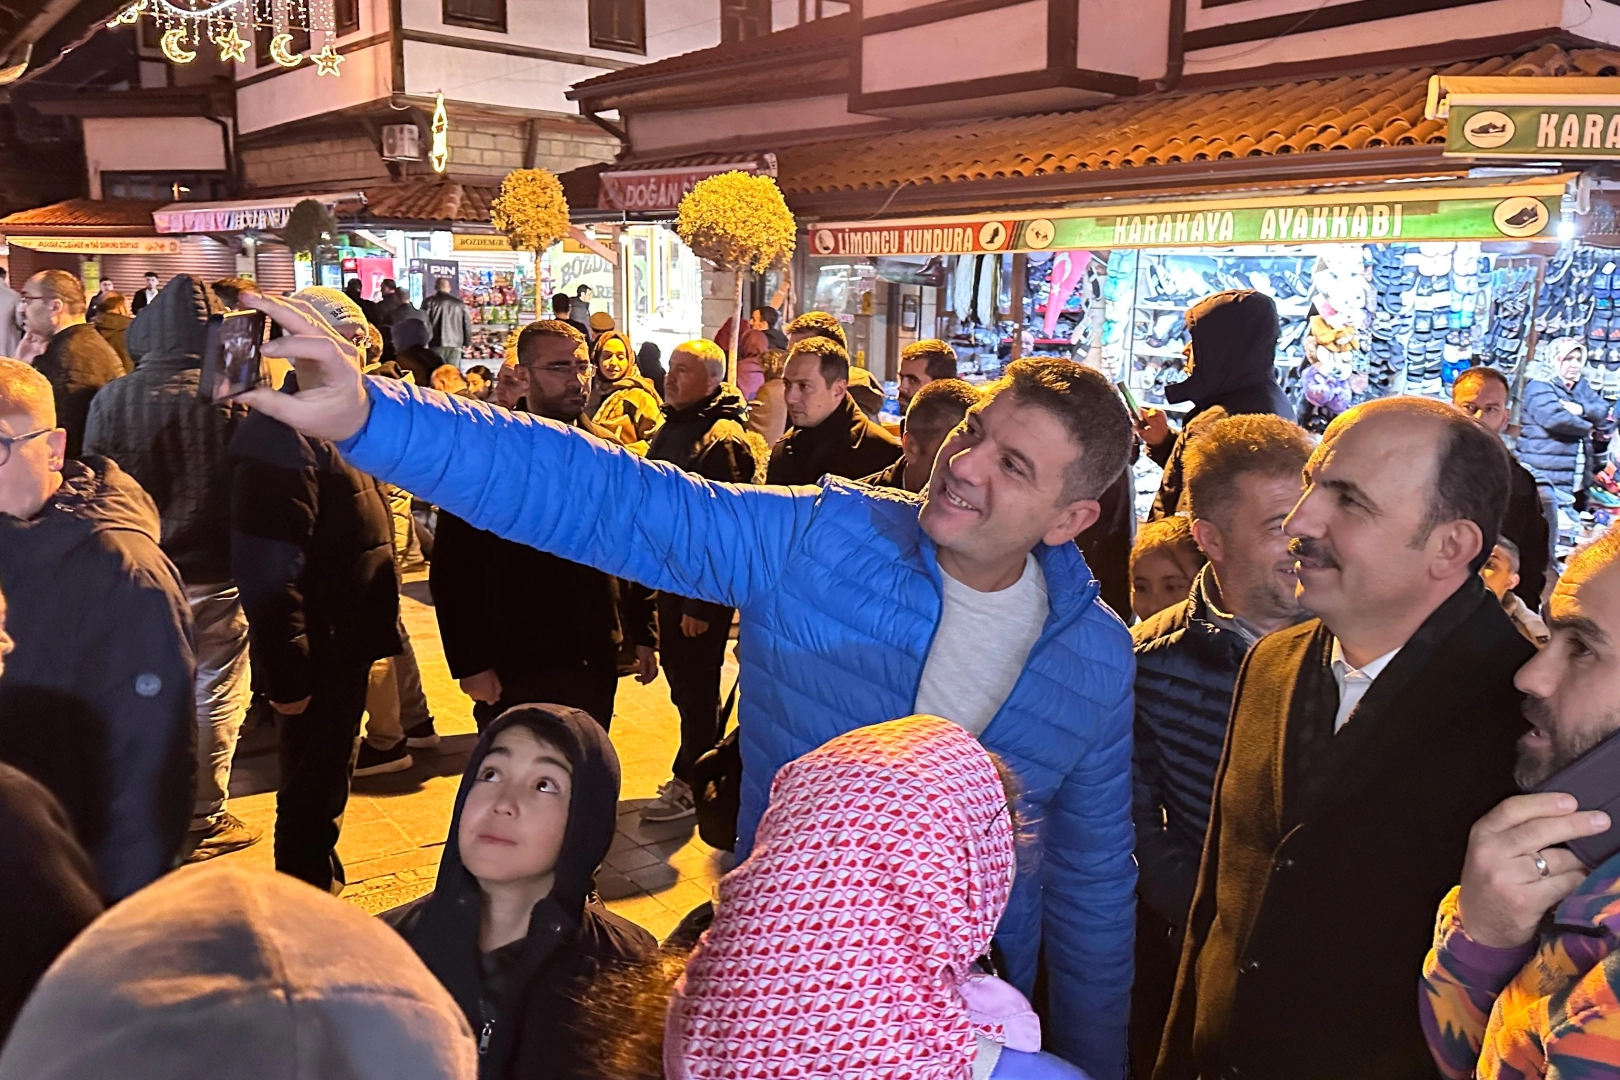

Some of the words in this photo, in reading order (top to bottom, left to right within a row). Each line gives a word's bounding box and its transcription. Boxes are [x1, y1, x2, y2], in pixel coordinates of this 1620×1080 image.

[1536, 113, 1620, 149] KARA
[625, 177, 679, 207] DOĞAN
[838, 228, 899, 254] LİMONCU
[903, 227, 973, 253] KUNDURA
[1113, 211, 1235, 245] KARAKAYA
[1260, 203, 1403, 242] AYAKKABI
